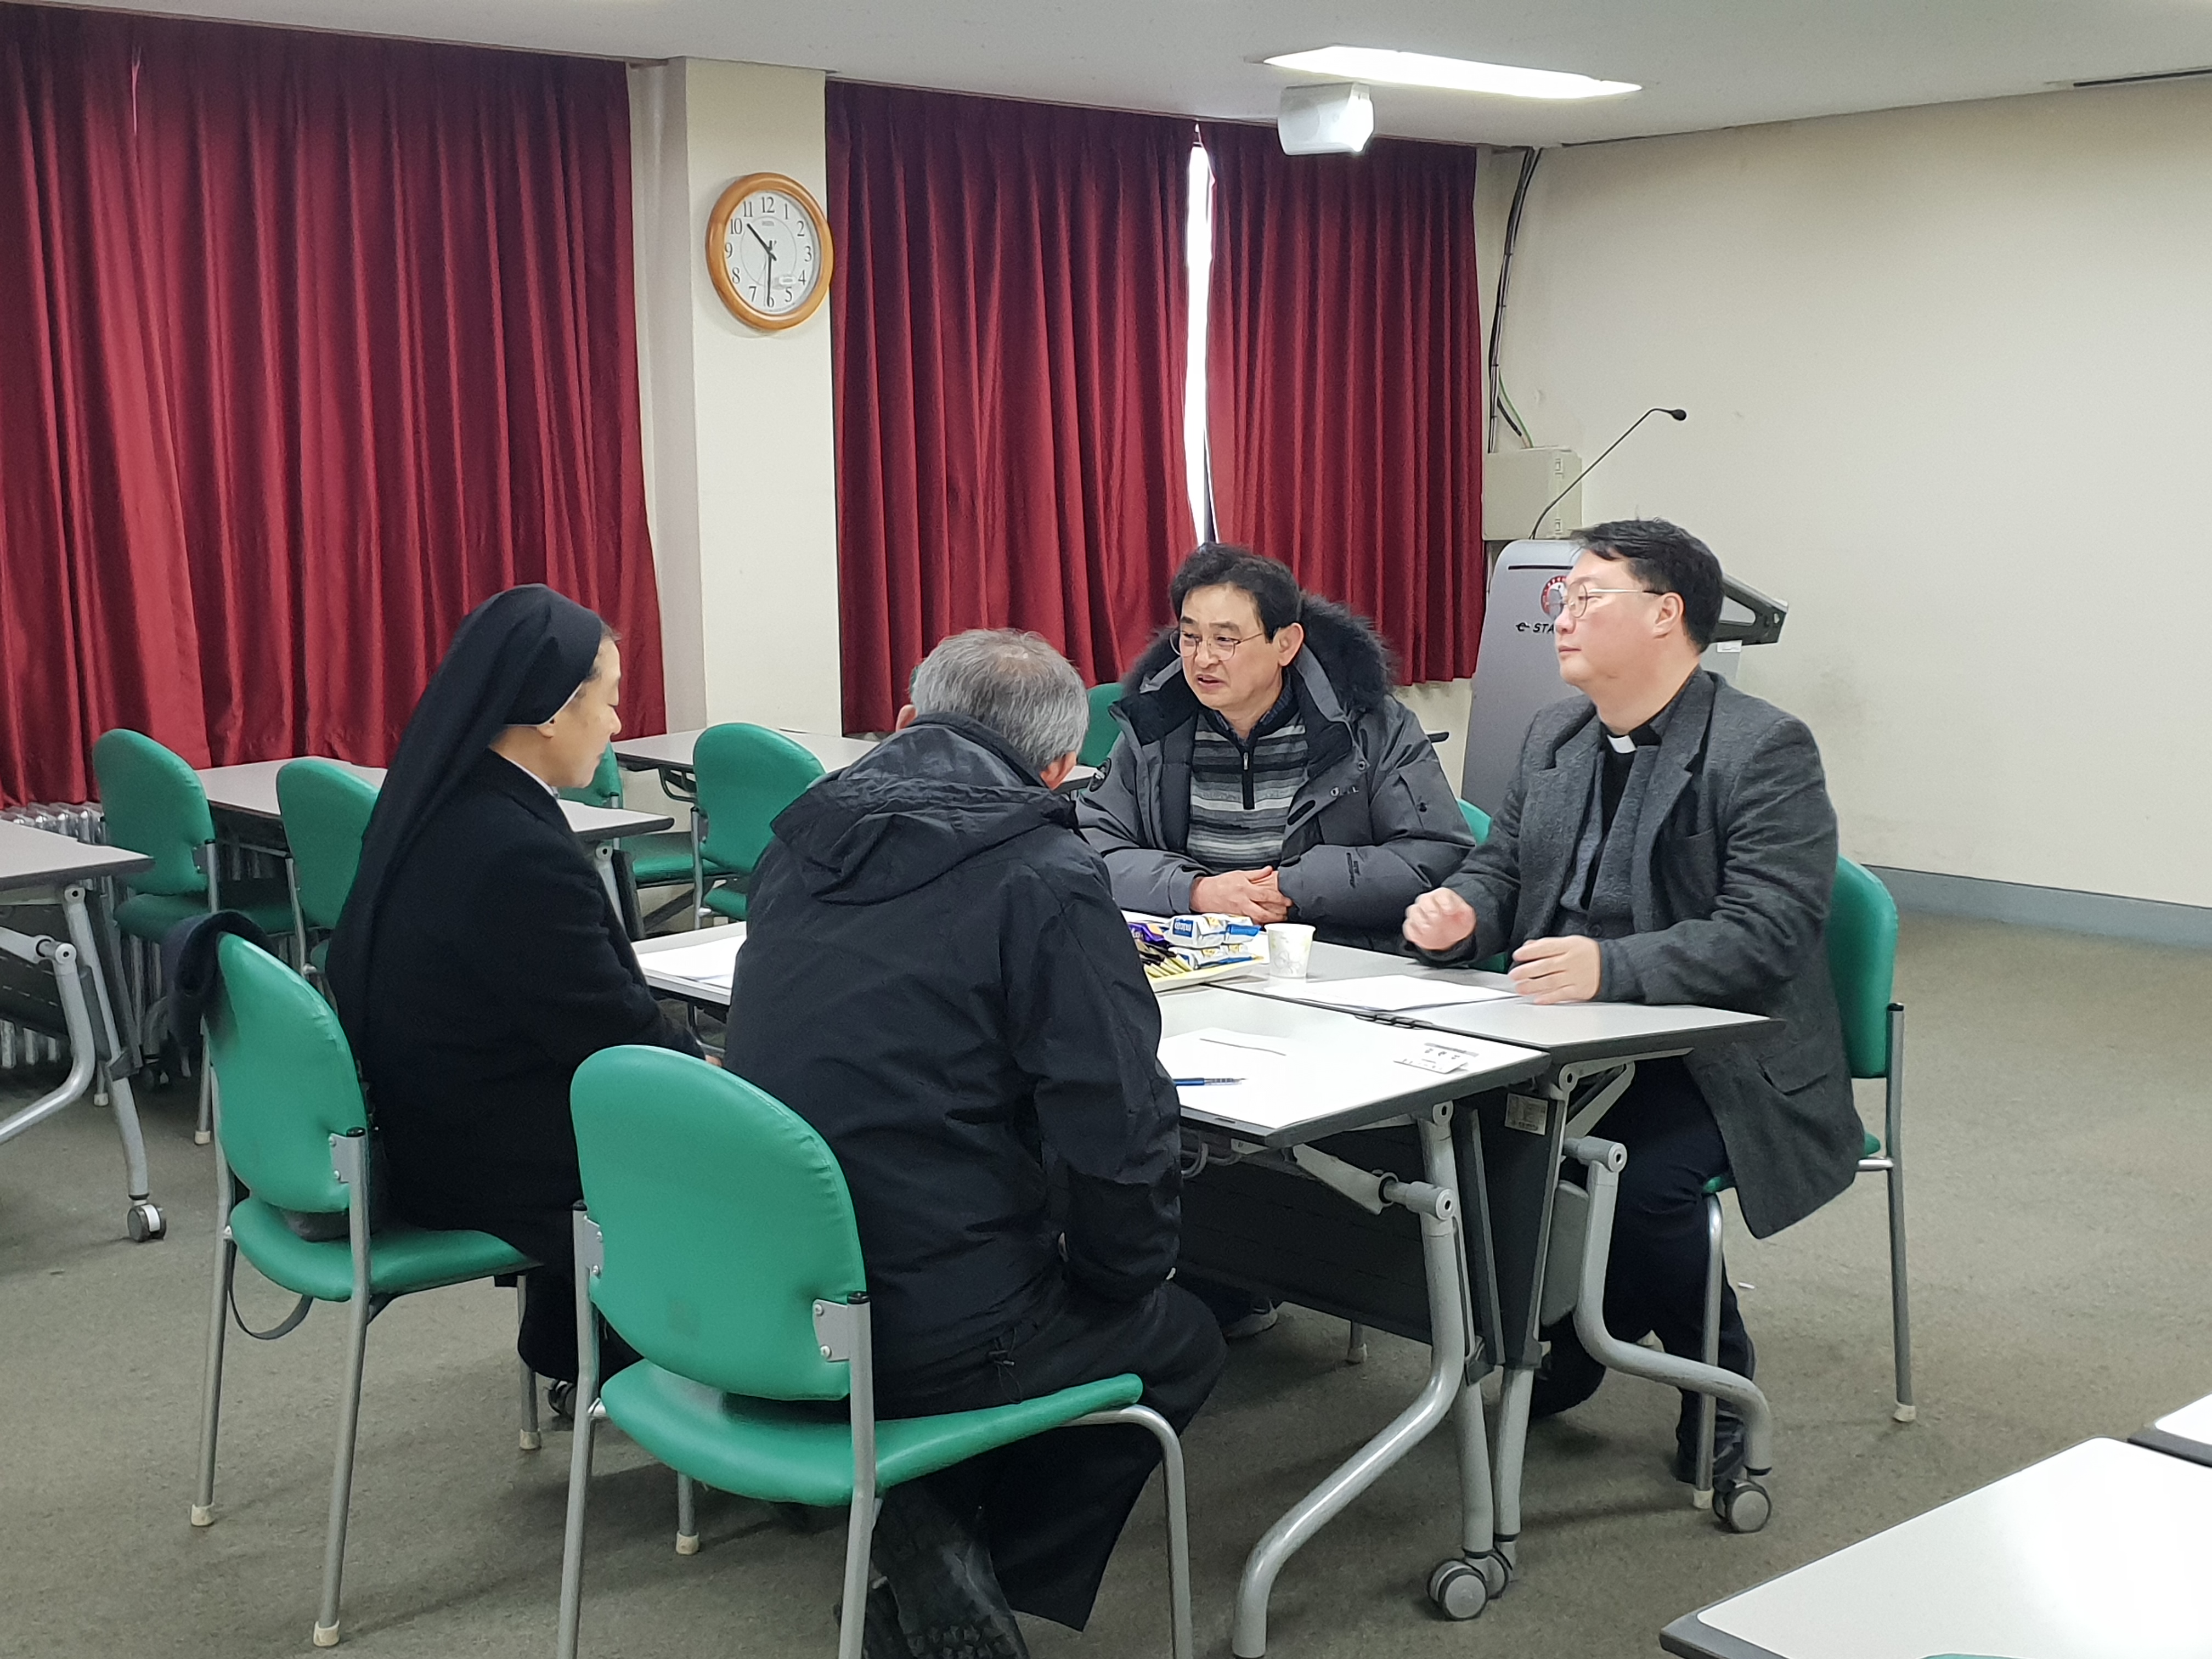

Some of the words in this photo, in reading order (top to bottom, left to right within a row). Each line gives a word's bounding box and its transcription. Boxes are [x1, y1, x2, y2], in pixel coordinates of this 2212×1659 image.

[743, 201, 753, 217] 11
[761, 196, 775, 213] 12
[785, 204, 788, 219] 1
[730, 219, 742, 234] 10
[797, 221, 805, 236] 2
[725, 242, 733, 259] 9
[804, 246, 812, 262] 3
[732, 267, 740, 284] 8
[798, 269, 806, 285] 4
[748, 286, 757, 302] 7
[785, 286, 792, 302] 5
